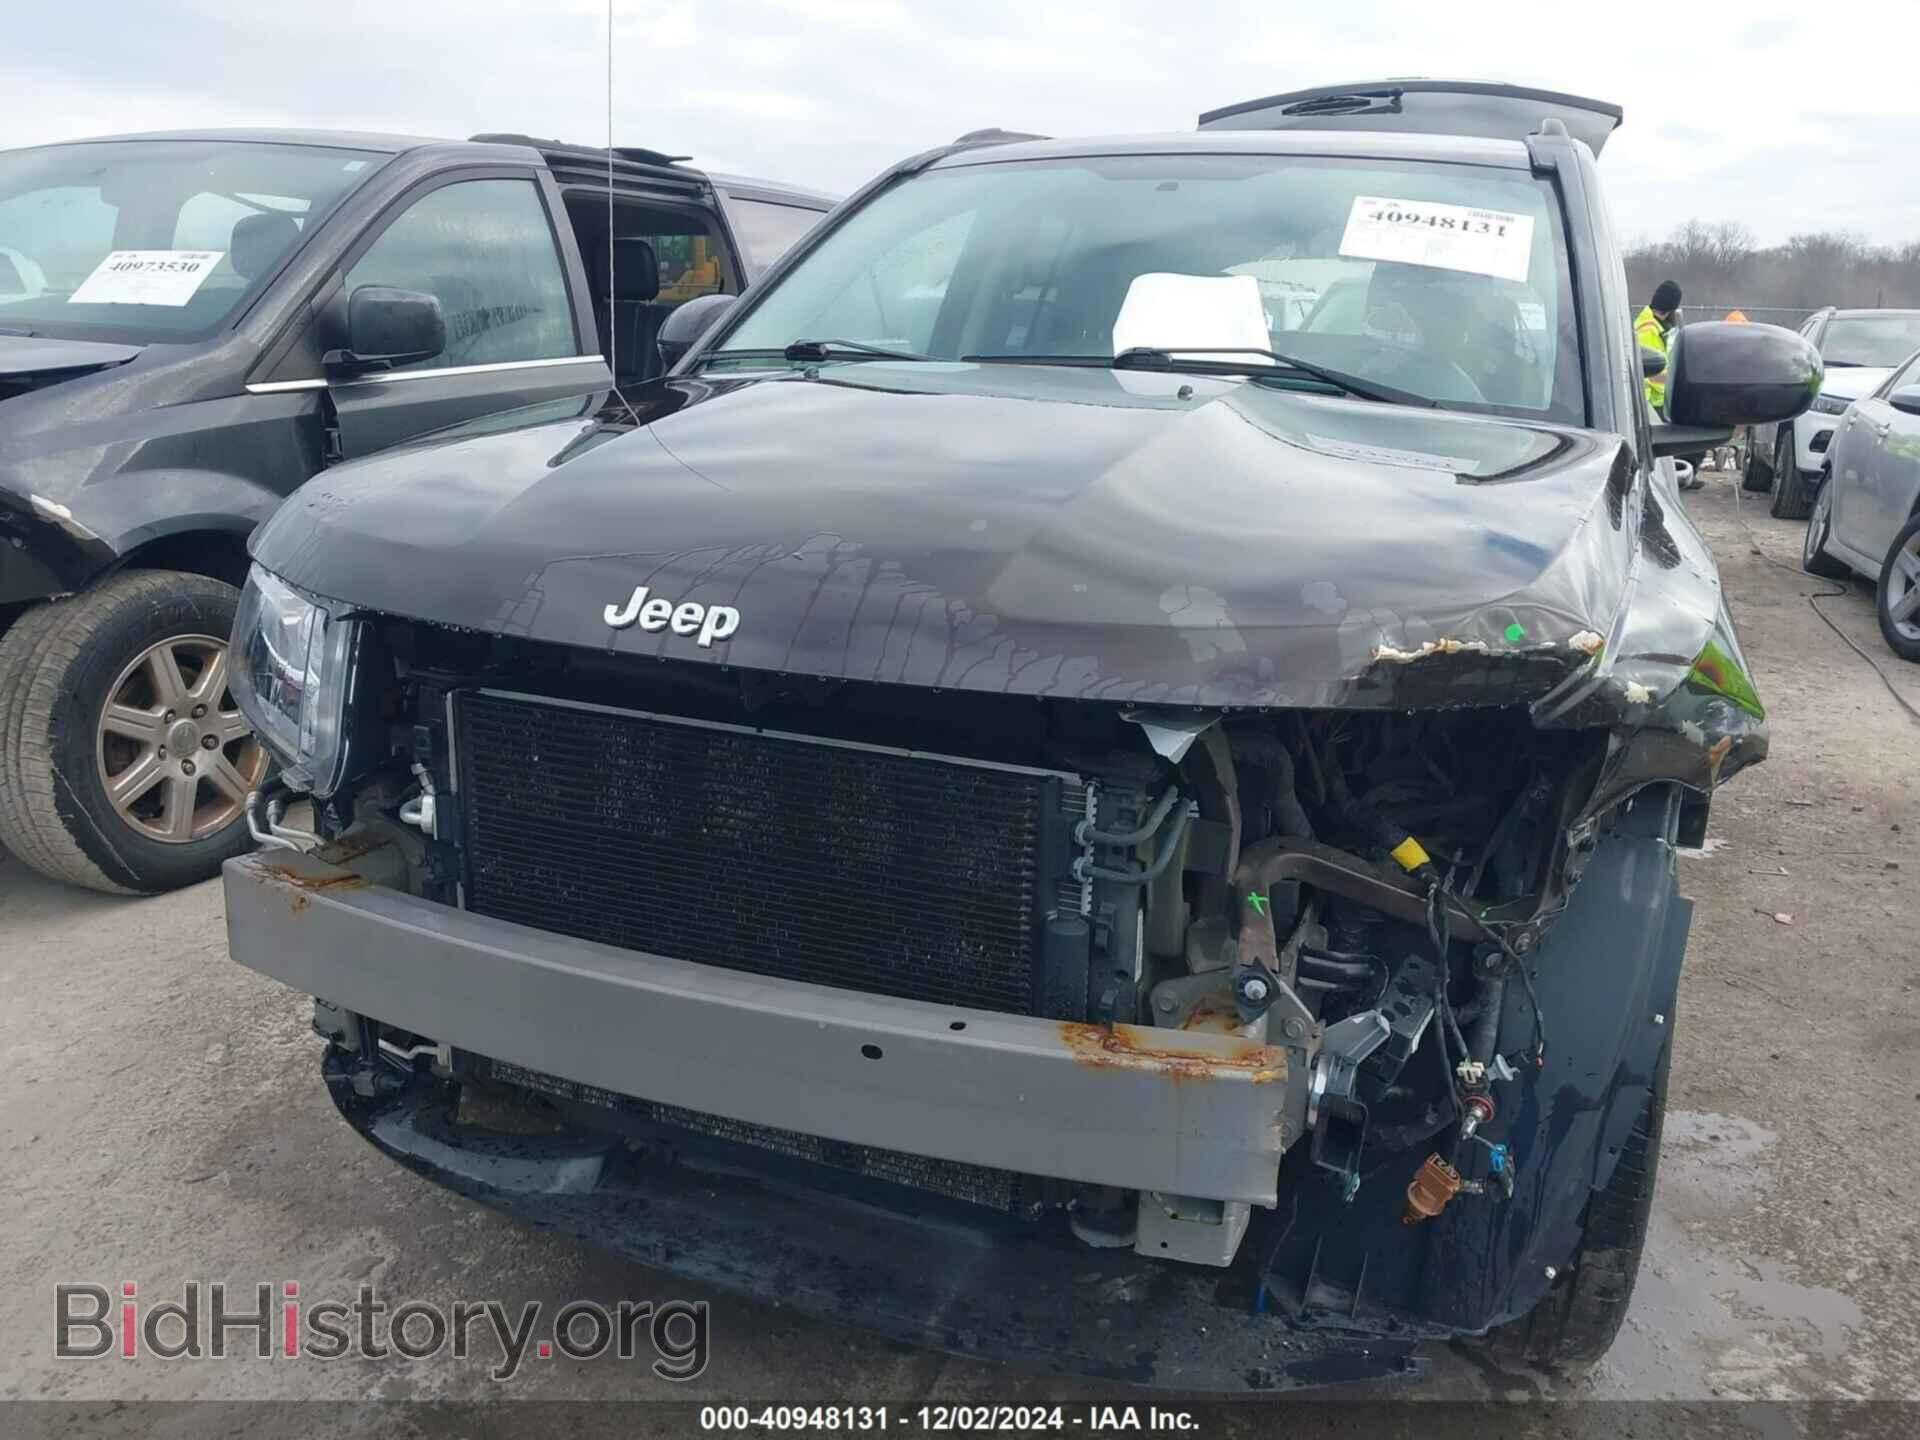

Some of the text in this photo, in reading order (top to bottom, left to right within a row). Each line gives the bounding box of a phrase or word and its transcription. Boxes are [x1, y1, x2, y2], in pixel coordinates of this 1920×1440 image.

[1368, 210, 1506, 237] 40948131
[109, 261, 201, 273] 40973530
[603, 586, 741, 648] Jeep
